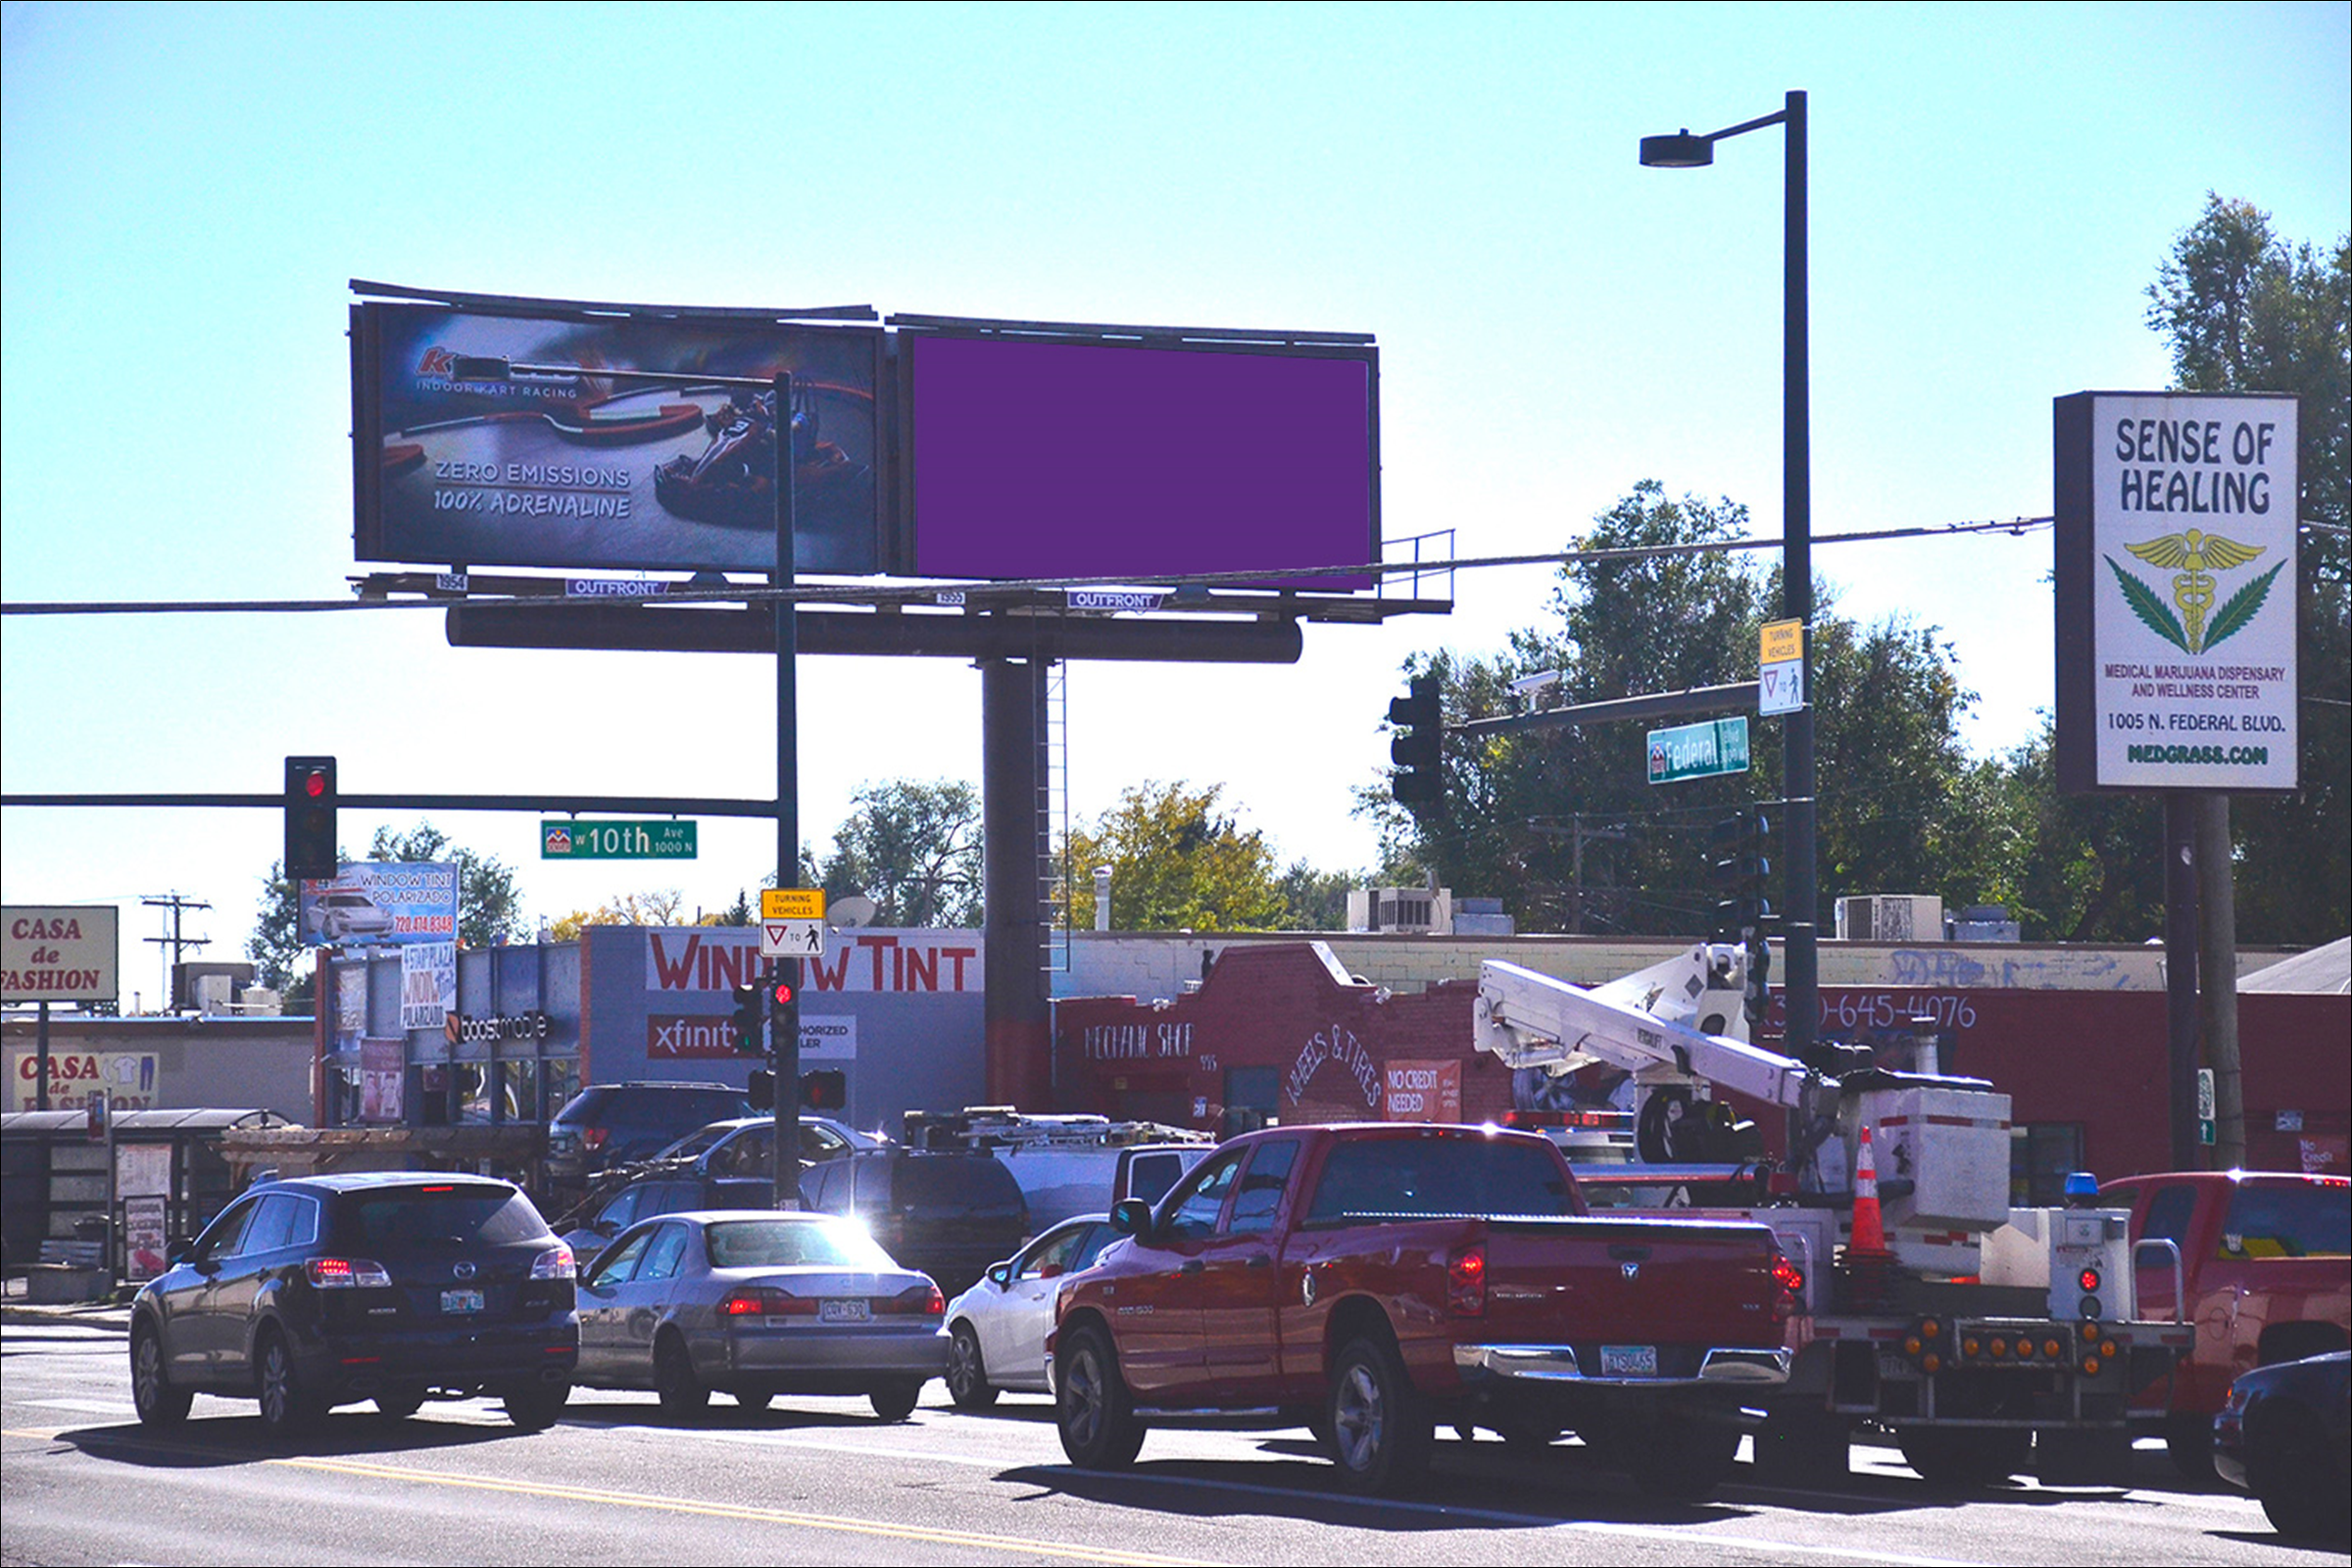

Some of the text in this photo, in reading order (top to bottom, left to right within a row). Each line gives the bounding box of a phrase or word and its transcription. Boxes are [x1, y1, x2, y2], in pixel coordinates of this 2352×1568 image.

[416, 380, 577, 399] INDOOR KART RACING
[2116, 418, 2276, 466] SENSE OF
[435, 462, 630, 487] ZERO EMISSIONS
[2121, 468, 2272, 514] HEALING
[434, 490, 631, 518] 100% ADRENALINE
[574, 580, 659, 596] OUTFRONT
[1076, 592, 1154, 607] OUTFRONT
[2104, 663, 2286, 682] MEDICAL MARIJUANA DISPENSARY
[2132, 683, 2260, 700] AND WELLNESS CENTER
[2107, 712, 2286, 733] 1005 N. FEDERAL BLVD.
[1666, 731, 1719, 772] Federal
[2128, 744, 2269, 765] MEDGRASS.COM
[589, 826, 650, 854] 10th
[663, 827, 684, 839] Ave
[655, 841, 693, 853] 1000 N
[360, 873, 424, 887] WINDOW
[425, 873, 453, 888] TINT
[371, 890, 453, 905] POLARIZADO
[774, 894, 811, 904] TURNING
[772, 906, 814, 916] VEHICLES
[11, 918, 82, 940] CASA
[790, 932, 802, 943] TO
[30, 946, 60, 964] de
[650, 933, 976, 992] WINDW TINT
[656, 1019, 739, 1054] xfinit
[799, 1025, 849, 1036] HORIZED
[1084, 1021, 1195, 1059] MECHANIC SHOP
[20, 1055, 100, 1081] CASA
[1286, 1031, 1329, 1107] WHEELS
[1345, 1030, 1382, 1107] TIRES
[49, 1081, 71, 1095] de
[1387, 1070, 1438, 1090] NO CREDIT
[1387, 1094, 1424, 1113] NEEDED
[2300, 1140, 2316, 1152] No
[2301, 1152, 2333, 1163] Credit
